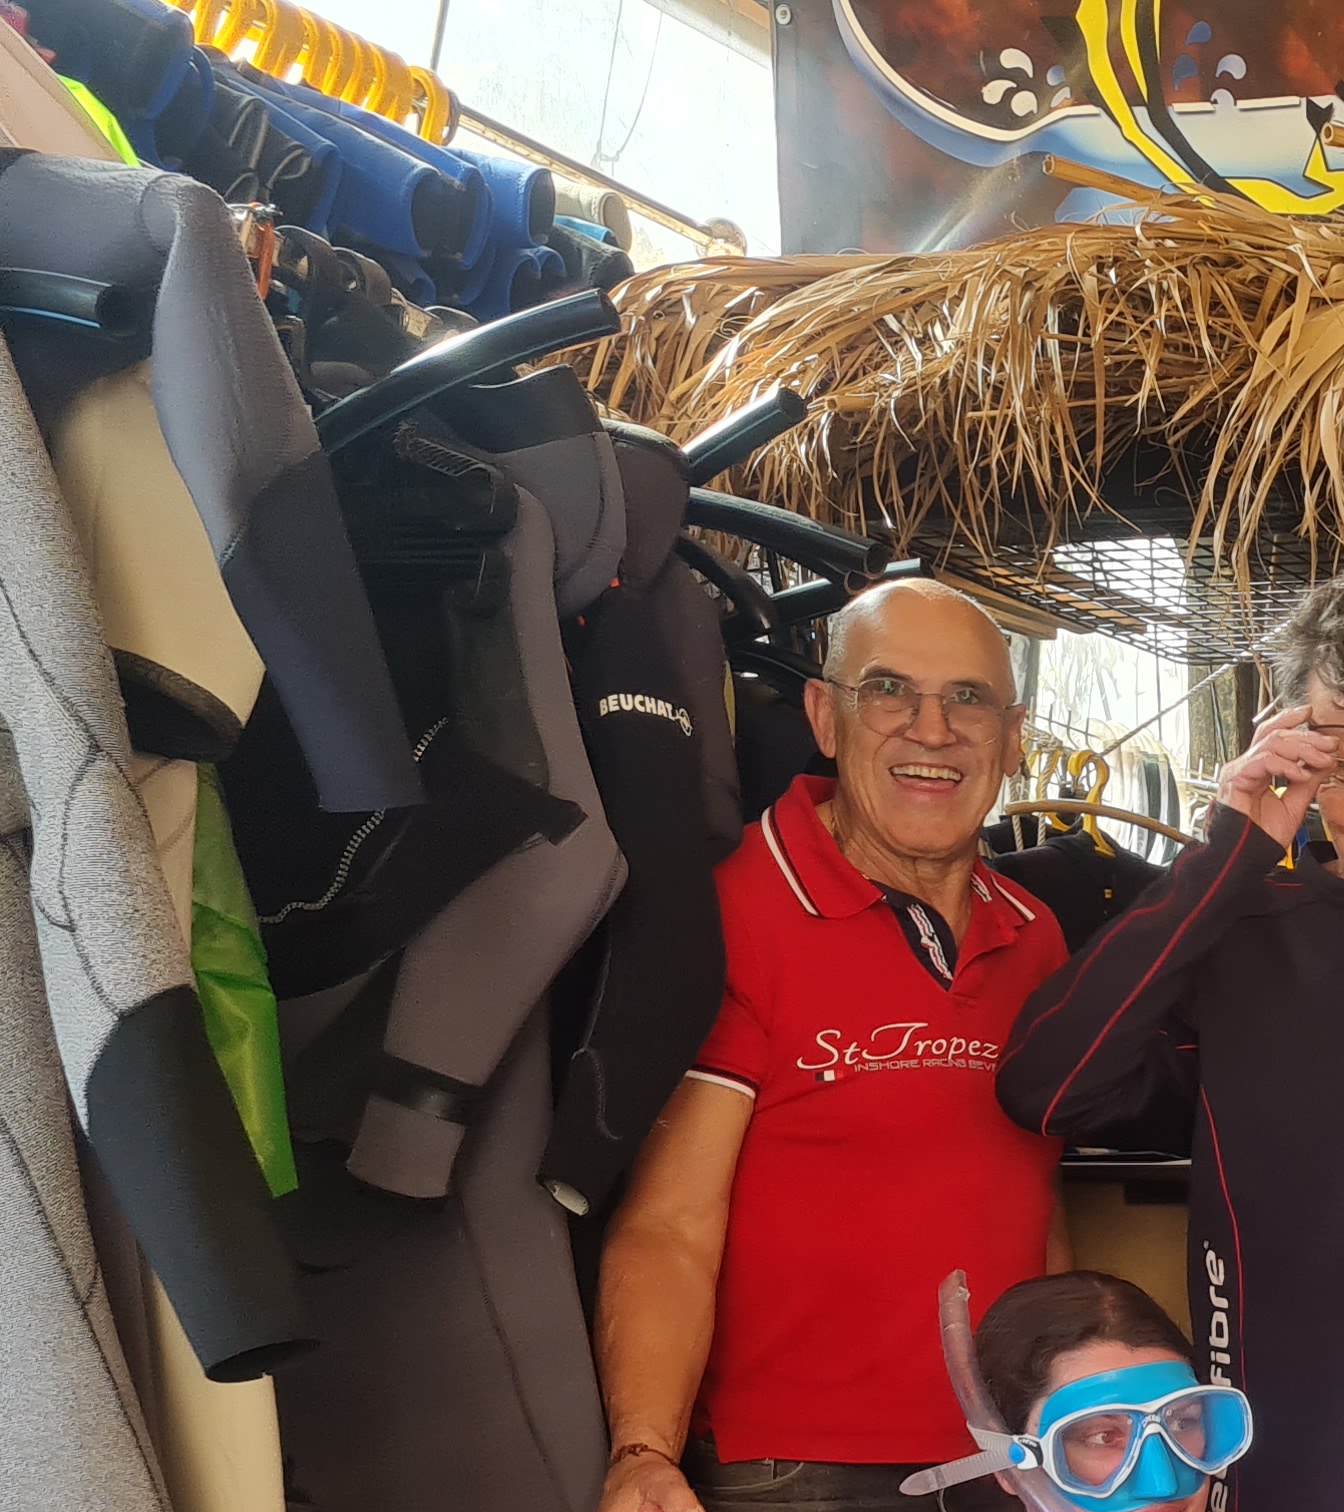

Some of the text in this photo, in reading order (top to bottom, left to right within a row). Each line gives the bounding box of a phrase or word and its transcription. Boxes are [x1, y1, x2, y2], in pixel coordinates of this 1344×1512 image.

[599, 692, 674, 720] BEUCHAT
[797, 1022, 1000, 1070] St Tropez
